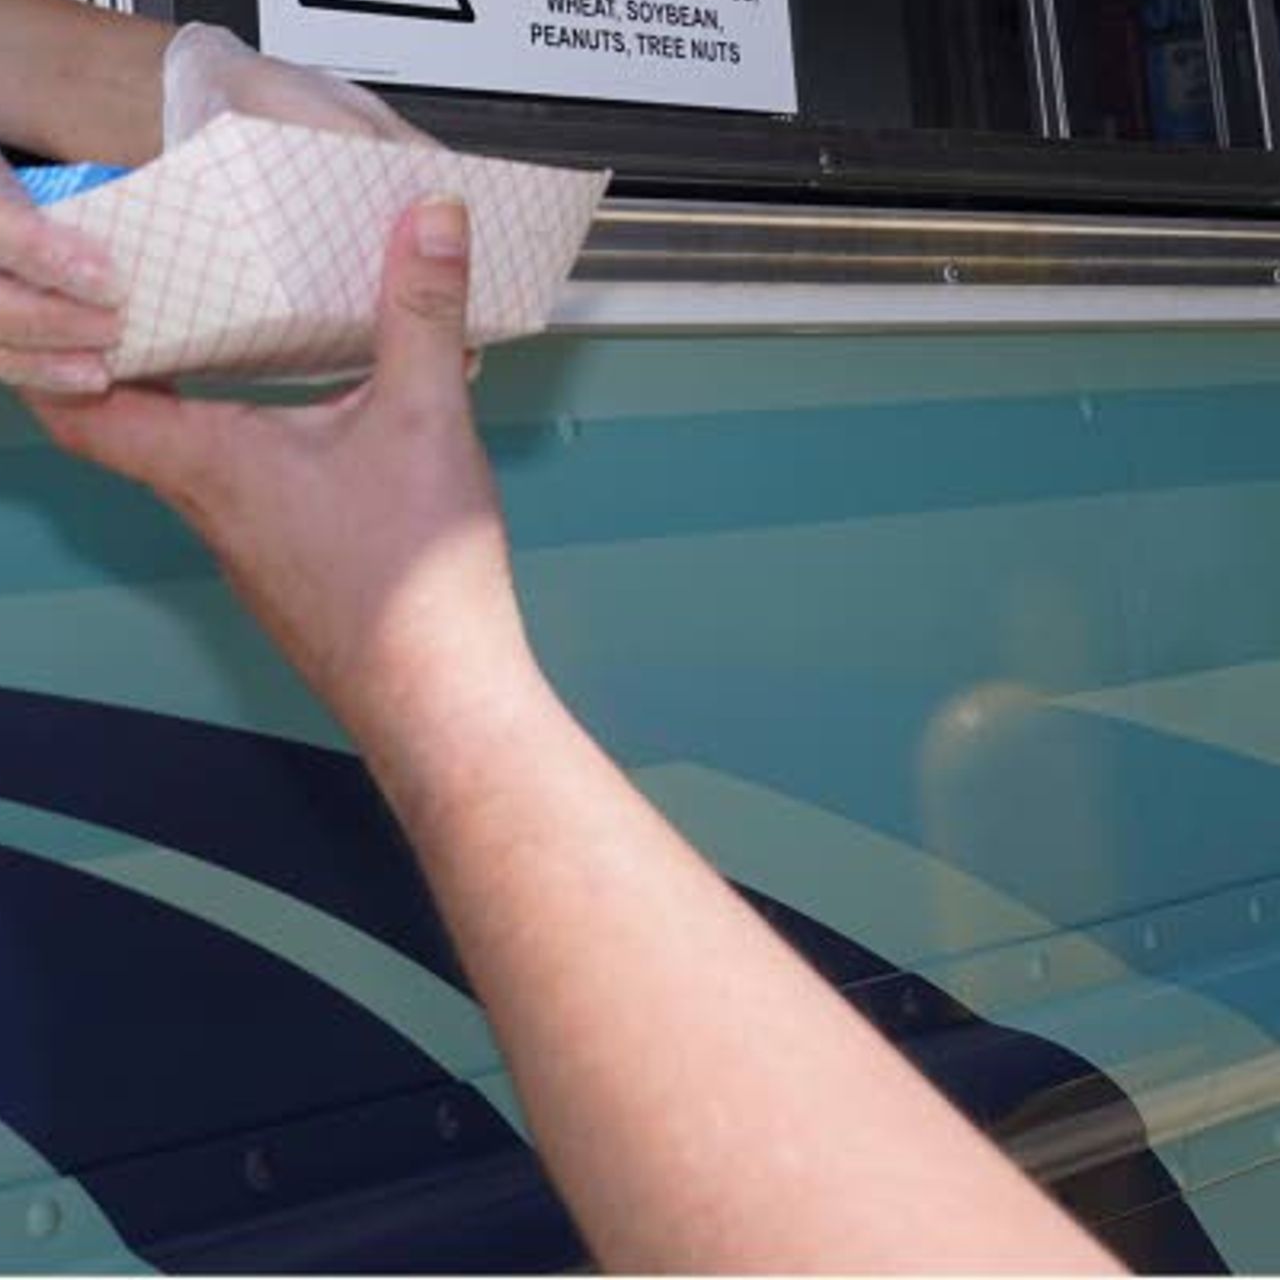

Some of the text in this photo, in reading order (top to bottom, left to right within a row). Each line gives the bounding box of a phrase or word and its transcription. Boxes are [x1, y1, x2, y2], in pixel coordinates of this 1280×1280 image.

[625, 0, 725, 33] SOYBEAN,
[530, 22, 742, 65] PEANUTS, TREE NUTS
